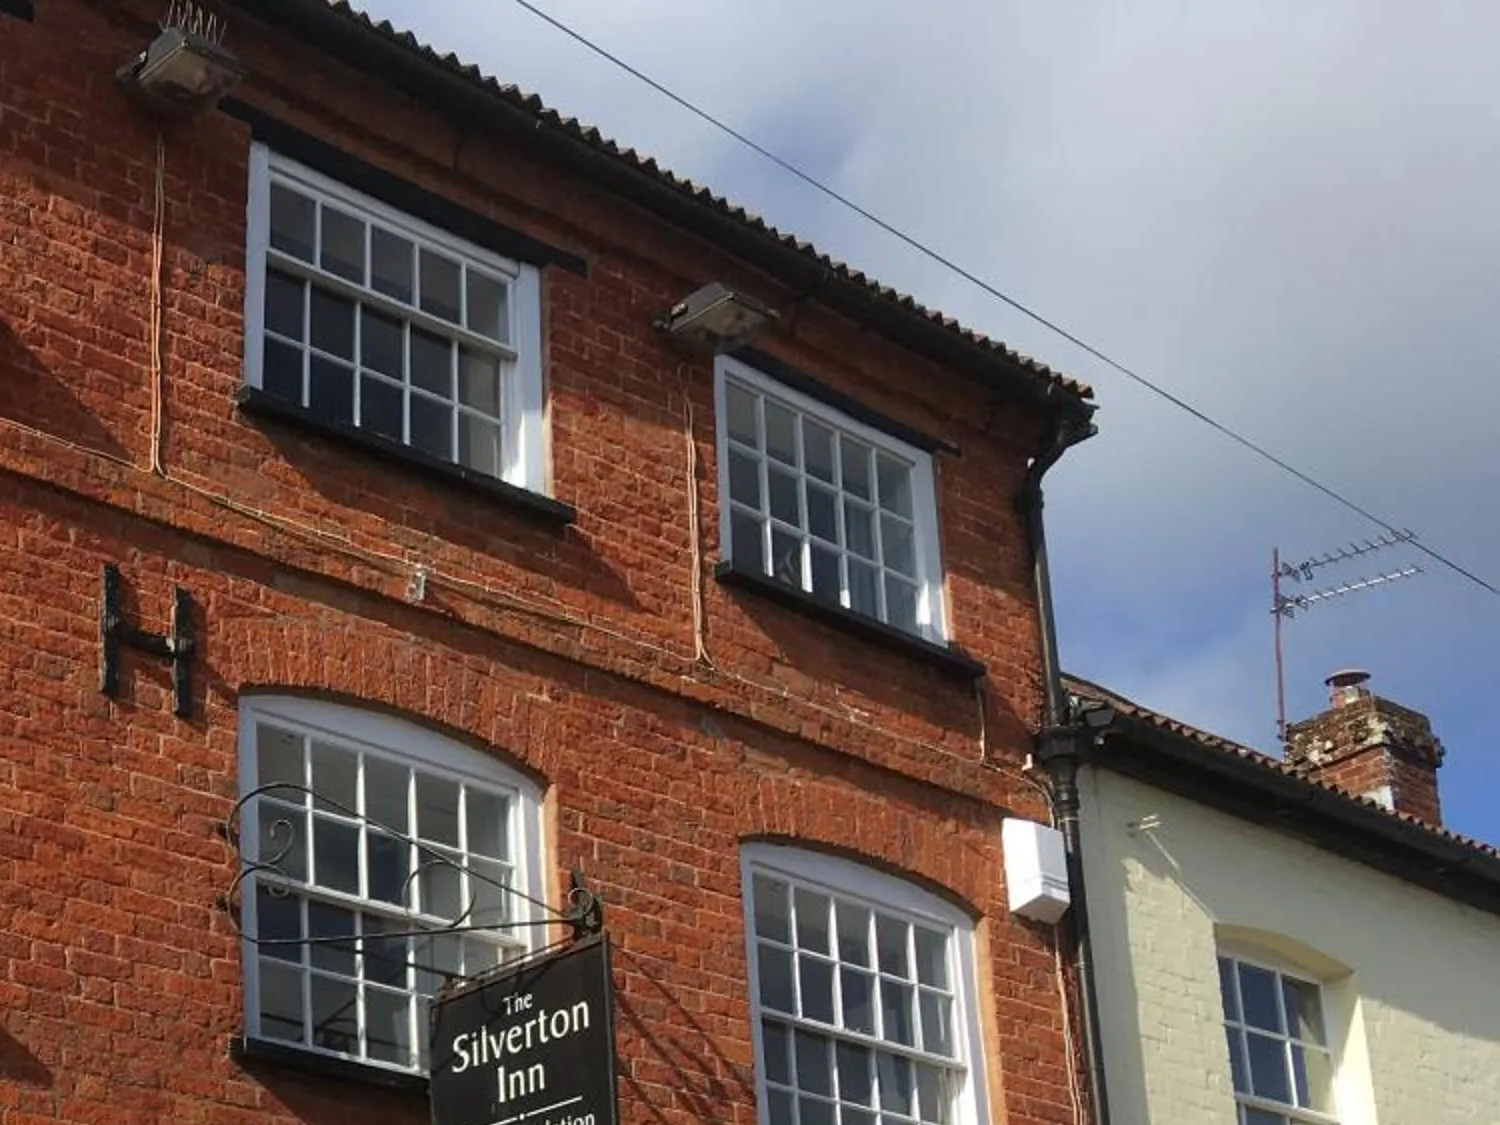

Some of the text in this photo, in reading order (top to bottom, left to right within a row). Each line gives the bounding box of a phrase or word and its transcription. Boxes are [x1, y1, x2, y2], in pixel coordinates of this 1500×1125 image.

[503, 992, 533, 1017] The
[452, 1001, 590, 1073] Silverton
[497, 1063, 546, 1103] Inn
